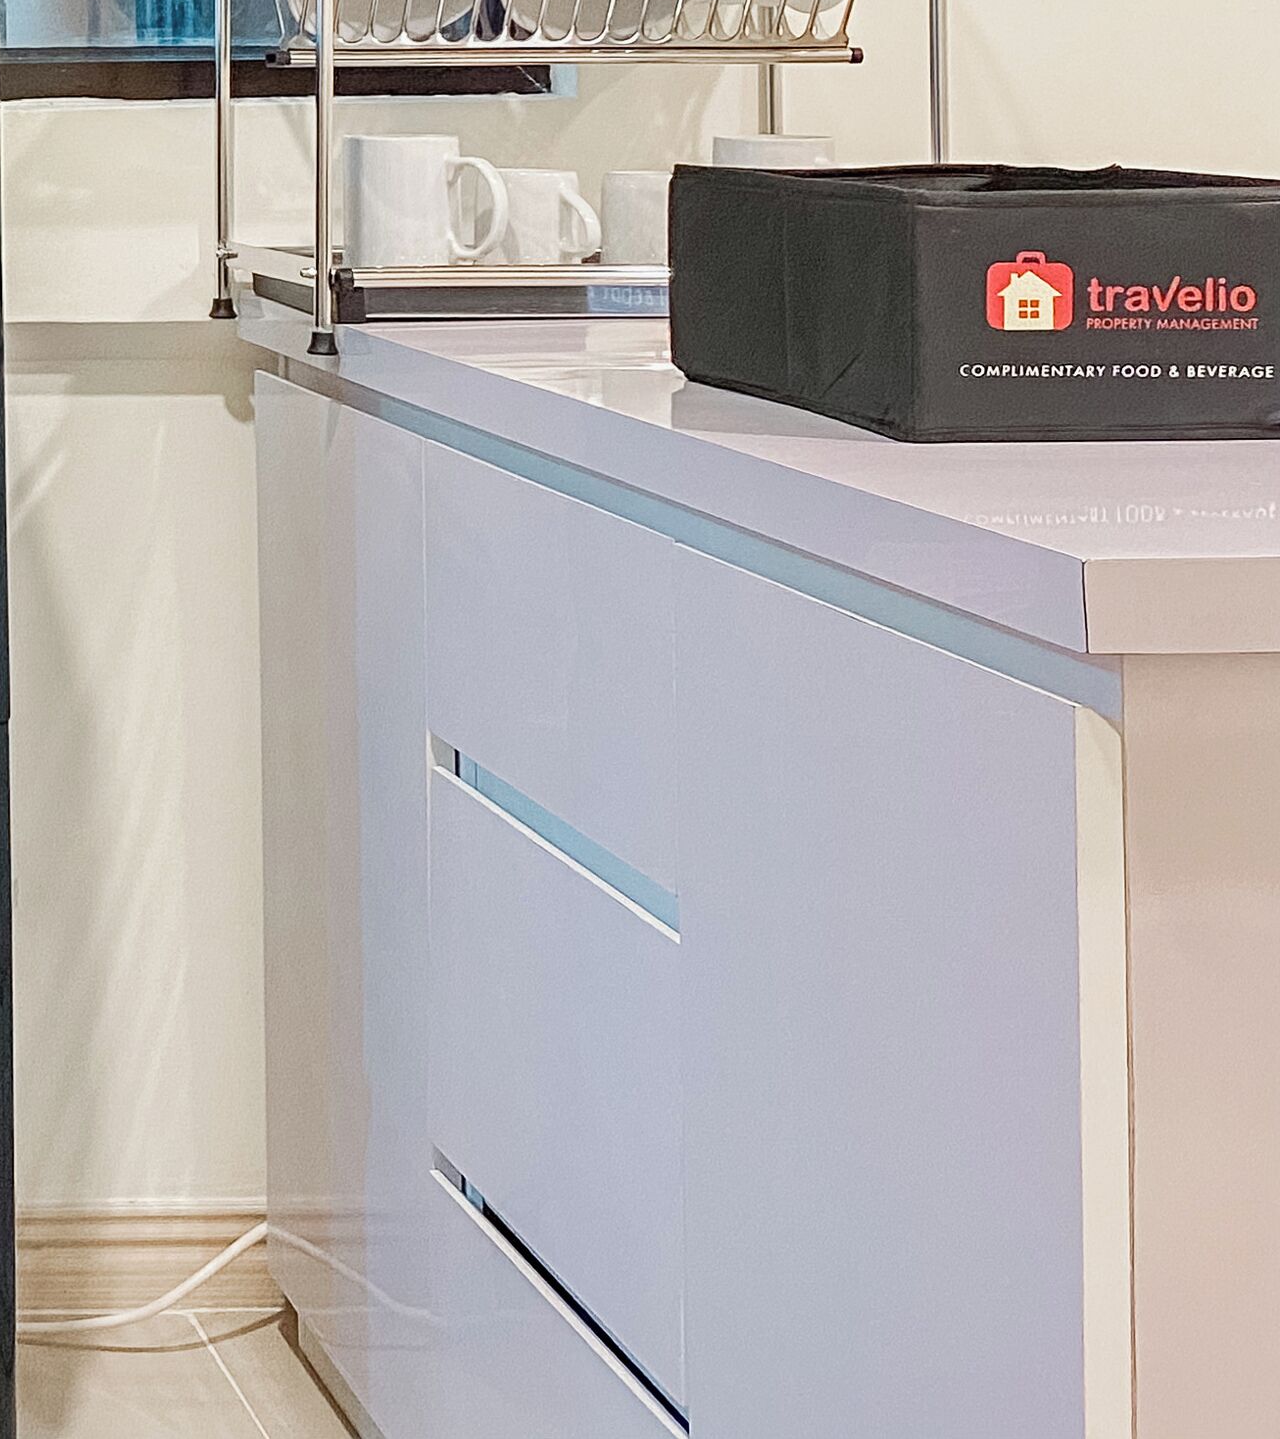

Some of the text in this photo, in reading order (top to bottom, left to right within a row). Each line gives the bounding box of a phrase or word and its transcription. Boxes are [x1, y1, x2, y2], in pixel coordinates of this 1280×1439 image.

[1086, 275, 1258, 313] travelio
[1086, 317, 1260, 330] PROPERTY MANAGEMENT
[959, 364, 1275, 379] COMPLIMENTARY FOOD & BEVERAGE
